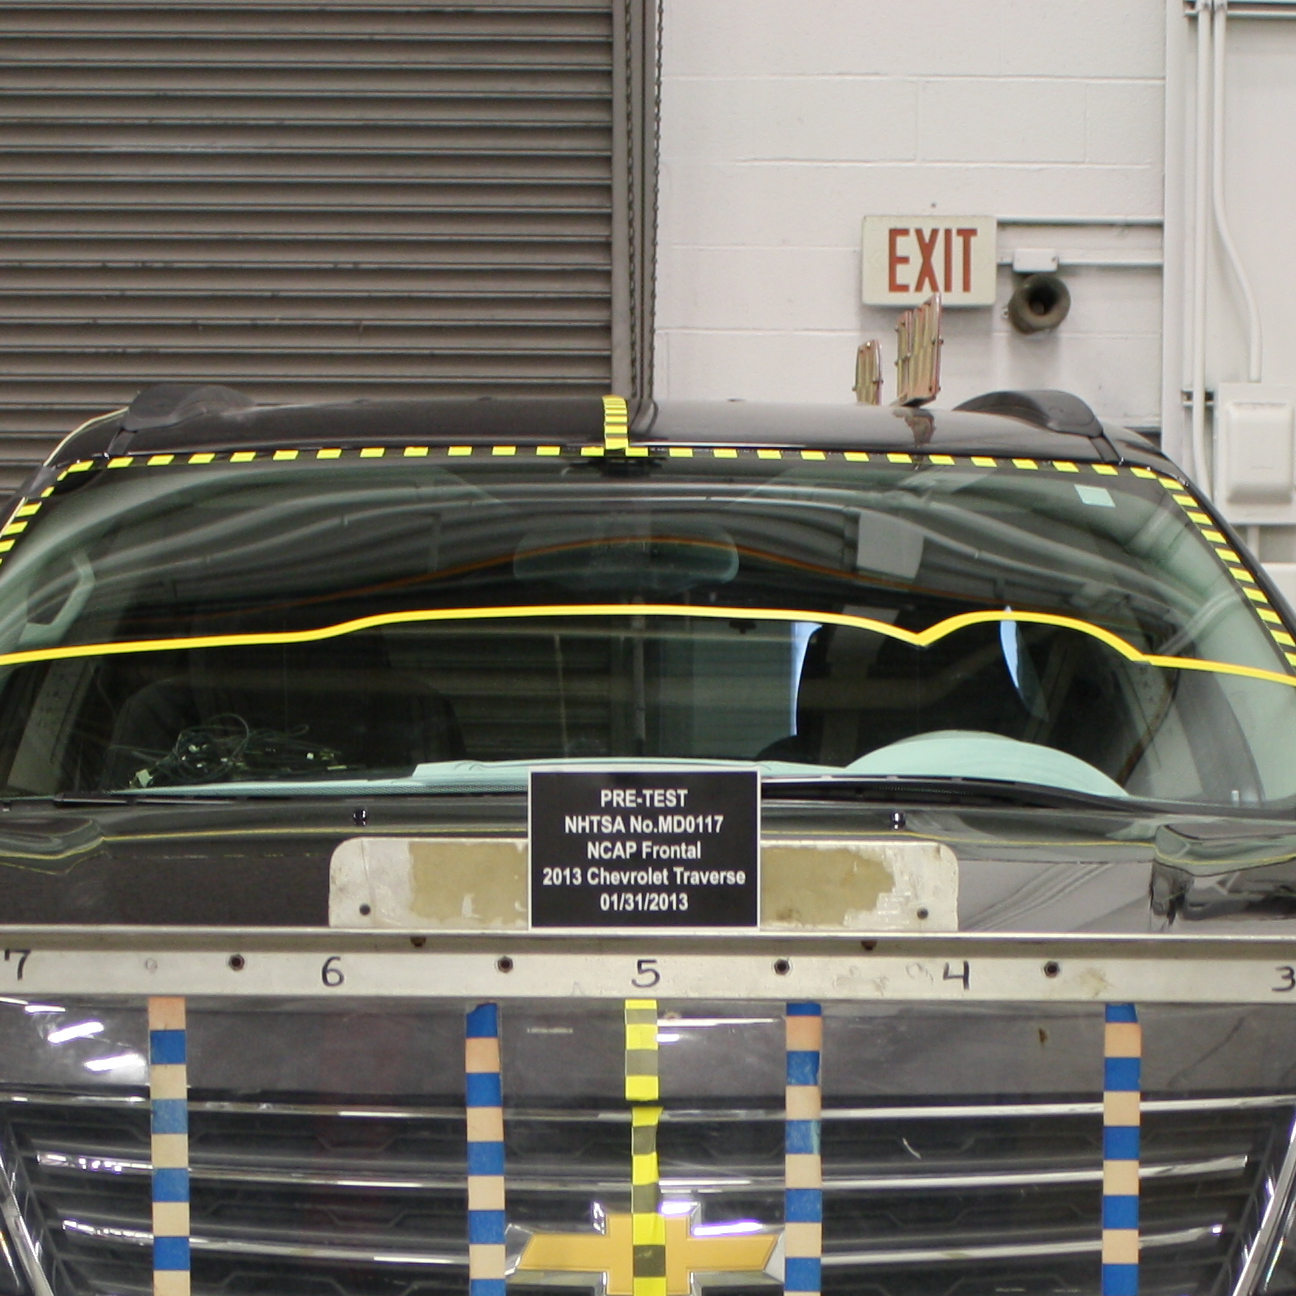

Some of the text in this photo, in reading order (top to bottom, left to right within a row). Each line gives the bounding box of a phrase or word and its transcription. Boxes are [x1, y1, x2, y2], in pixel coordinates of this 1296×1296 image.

[888, 228, 977, 293] EXIT
[600, 789, 689, 808] PRE-TEST
[564, 815, 724, 834] NHTSA No.MD0117
[587, 840, 701, 859] NCAP Frontal
[542, 866, 746, 885] 2013 Chevrolet Traverse
[600, 892, 689, 911] 01/31/2013
[4, 948, 32, 981] 7
[321, 956, 345, 987] 6
[636, 959, 661, 988] 5
[943, 961, 970, 990] 4
[1272, 966, 1296, 992] 3
